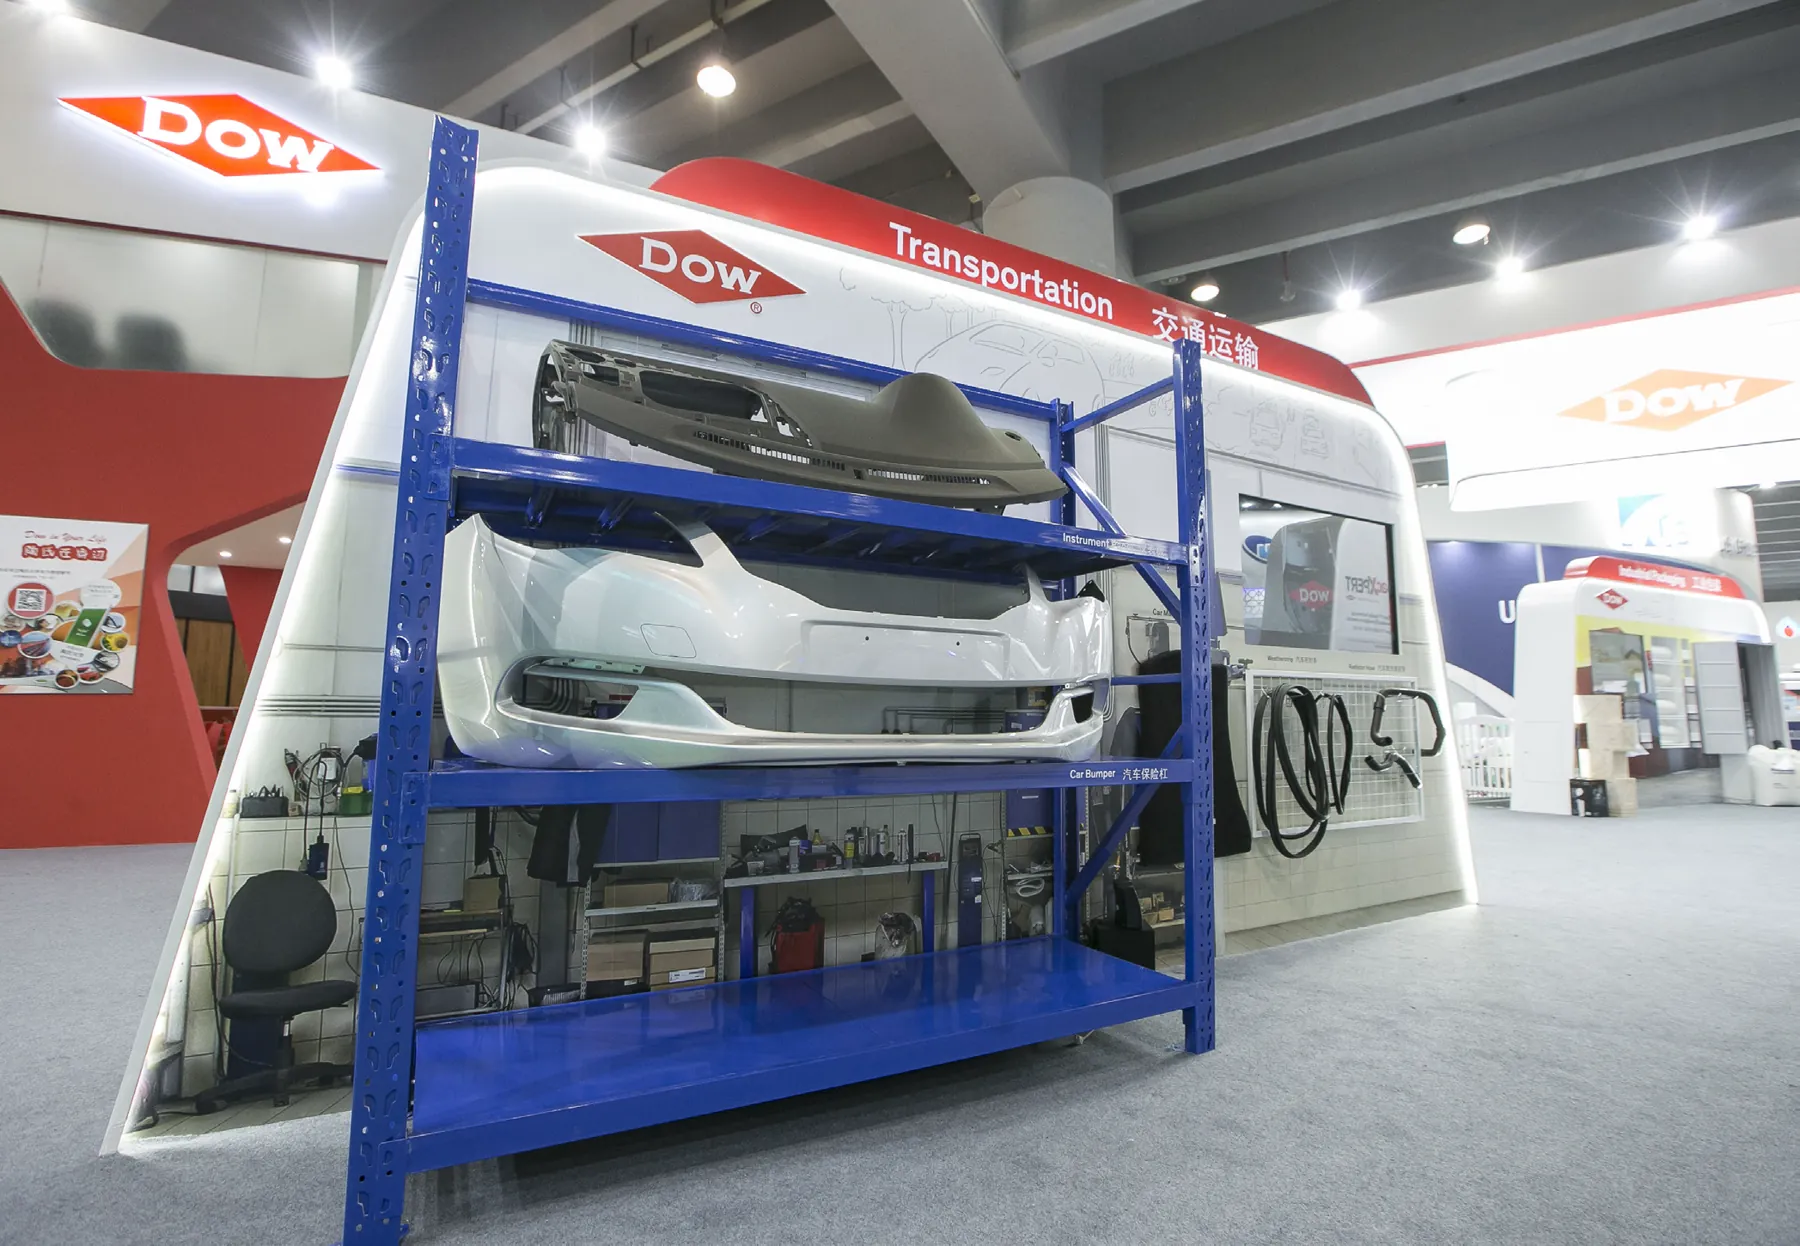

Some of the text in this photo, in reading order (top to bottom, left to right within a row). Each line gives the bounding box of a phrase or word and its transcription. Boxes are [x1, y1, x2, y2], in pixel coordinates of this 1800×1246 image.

[137, 96, 334, 173] DOW
[639, 237, 761, 295] DOW
[889, 221, 1113, 320] Transportation
[1152, 307, 1259, 370] 交通运输
[1603, 378, 1746, 422] DOW
[1062, 532, 1109, 548] Instrument
[1299, 588, 1329, 602] DOW
[1152, 608, 1162, 616] Car
[1069, 769, 1116, 780] Car Bumper
[1122, 768, 1168, 781] 汽车保险杠
